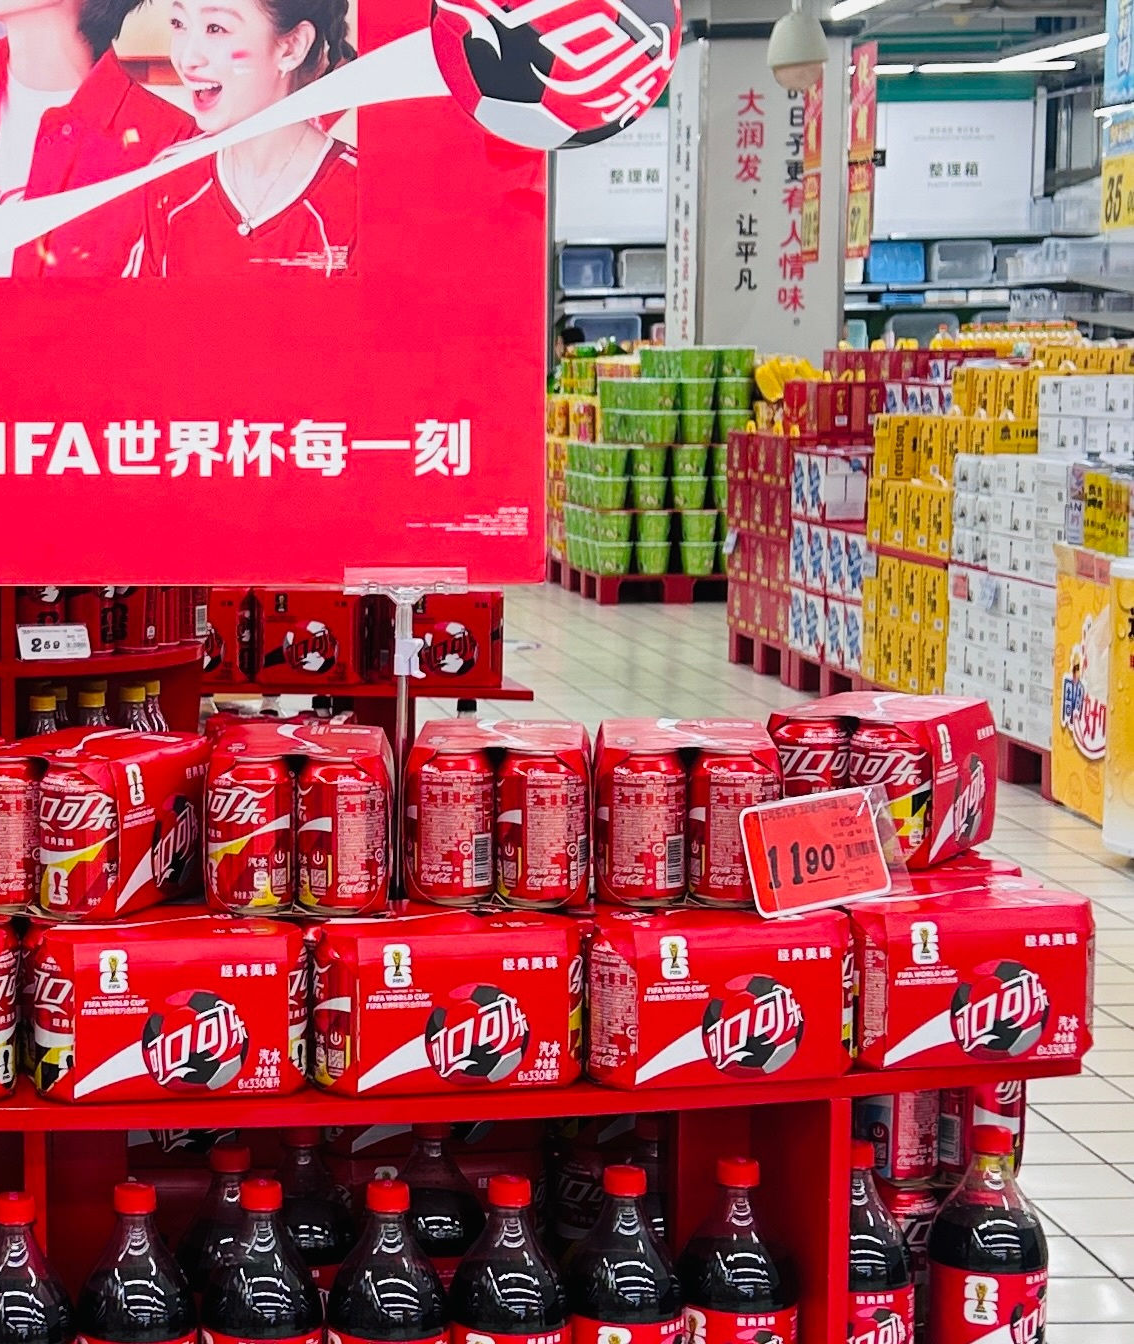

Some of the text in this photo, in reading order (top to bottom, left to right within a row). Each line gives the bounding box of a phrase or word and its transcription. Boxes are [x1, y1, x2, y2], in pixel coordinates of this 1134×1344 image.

[609, 168, 660, 184] 整理箱
[929, 161, 979, 177] 整理箱
[850, 749, 928, 786] 口可乐
[40, 790, 117, 832] 口可乐
[1025, 933, 1078, 947] 经典美味
[777, 946, 832, 962] 经典美味
[220, 963, 278, 978] 经典美味
[502, 956, 558, 971] 经典美味
[1058, 1015, 1079, 1031] 汽水
[259, 1049, 281, 1064] 汽水
[538, 1041, 561, 1057] 汽水
